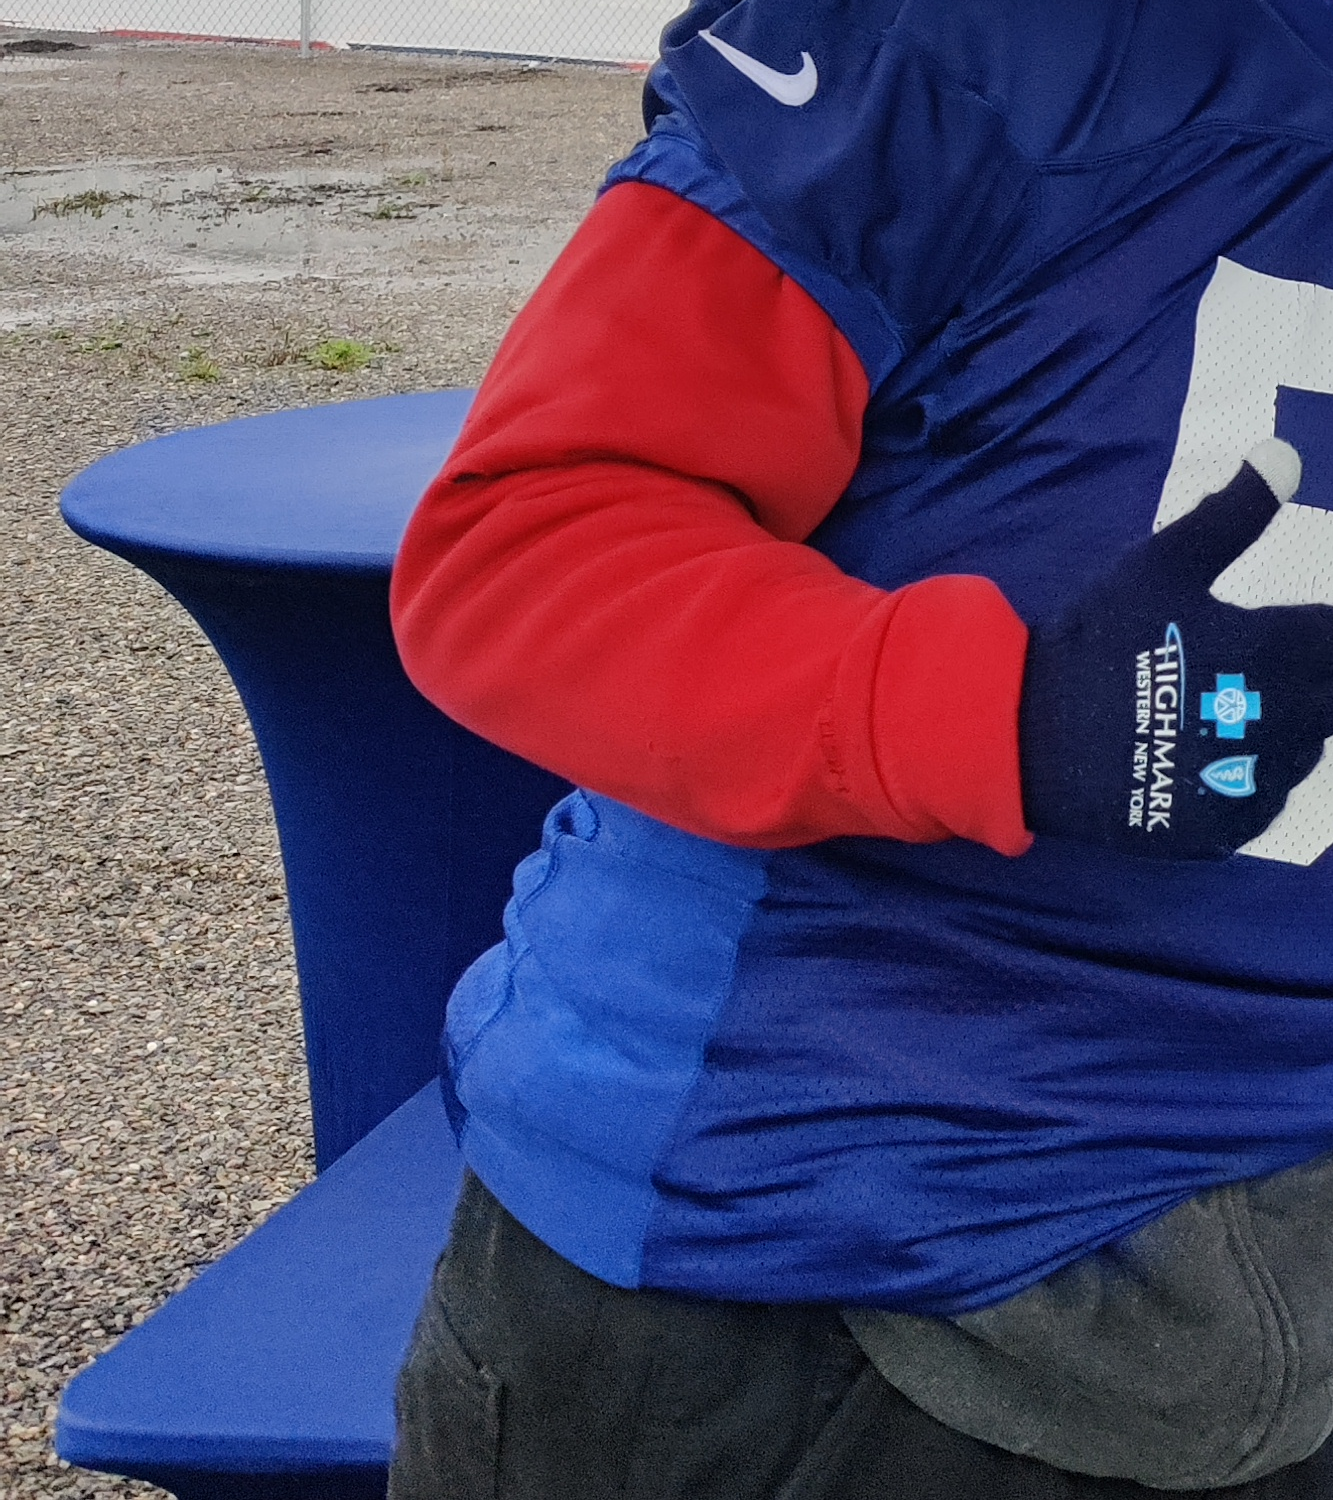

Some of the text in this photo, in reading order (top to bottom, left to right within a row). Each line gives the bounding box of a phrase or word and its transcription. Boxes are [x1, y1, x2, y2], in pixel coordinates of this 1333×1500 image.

[1128, 650, 1151, 828] WESTERN NEW YORK
[1148, 644, 1179, 830] HIGHMARK
